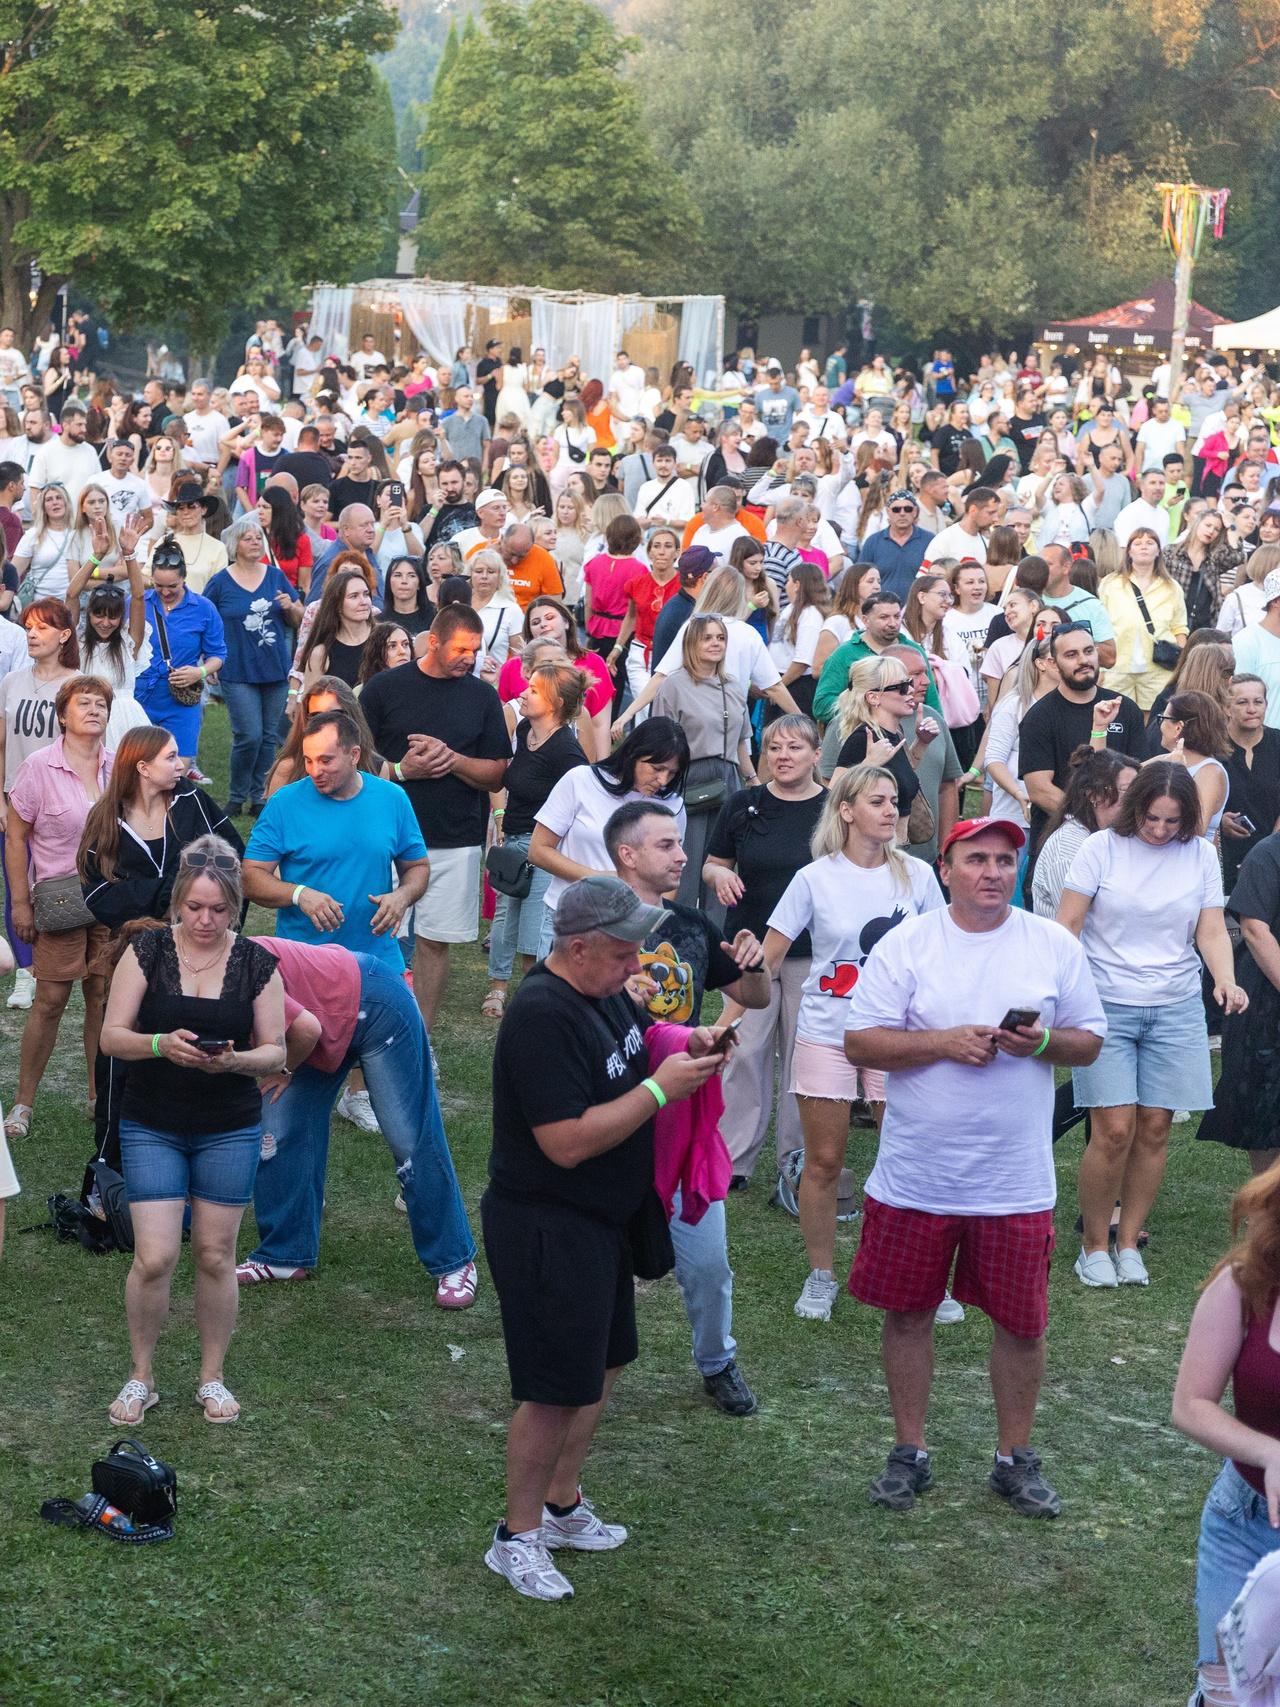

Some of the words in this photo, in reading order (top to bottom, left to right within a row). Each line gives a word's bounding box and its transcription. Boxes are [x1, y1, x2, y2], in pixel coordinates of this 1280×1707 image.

[1043, 329, 1064, 342] burn
[1088, 331, 1109, 343] burn
[1133, 332, 1155, 345] burn
[1185, 336, 1201, 347] urn
[14, 699, 56, 738] JUST
